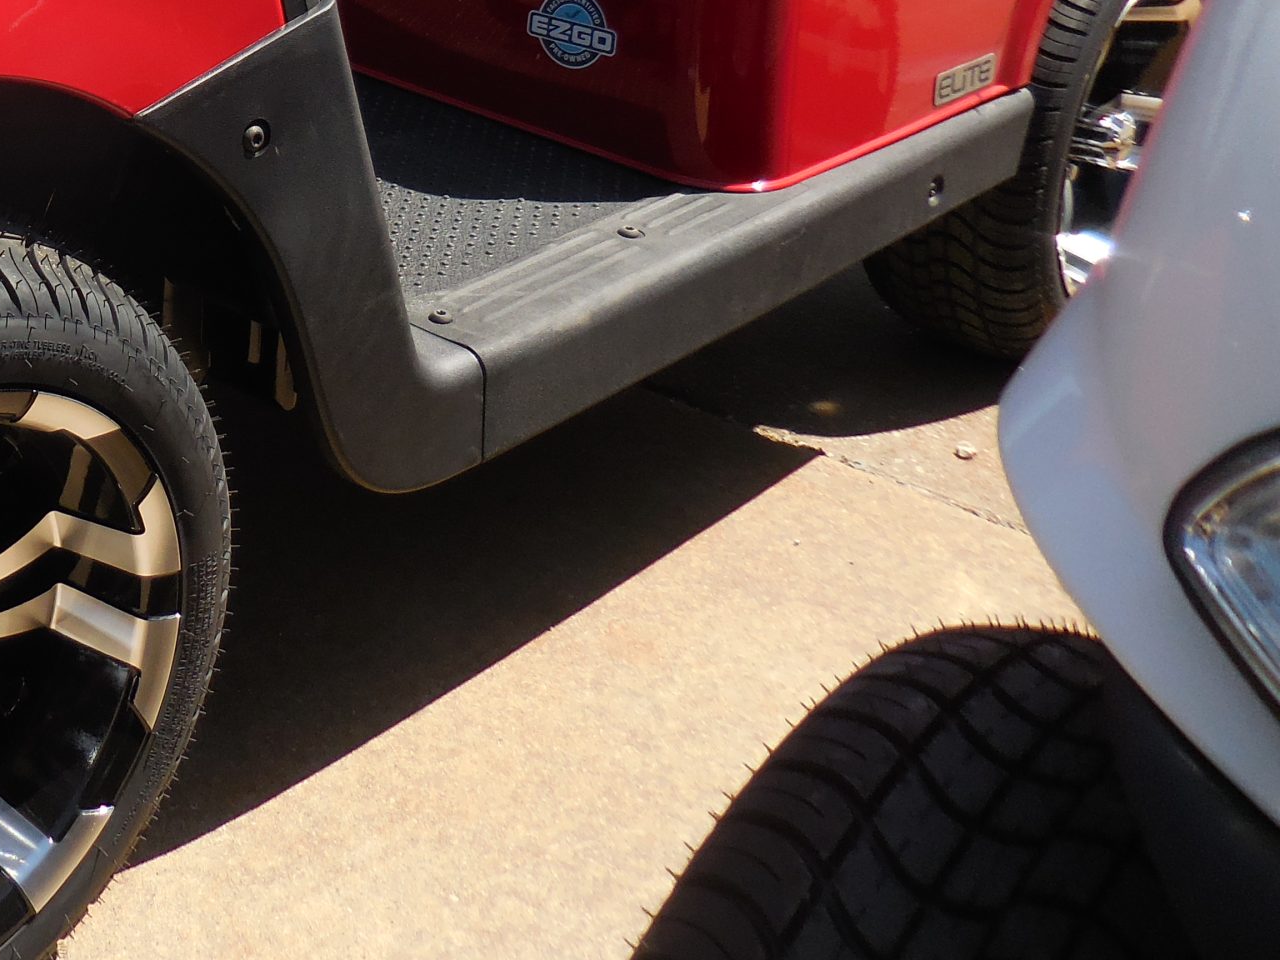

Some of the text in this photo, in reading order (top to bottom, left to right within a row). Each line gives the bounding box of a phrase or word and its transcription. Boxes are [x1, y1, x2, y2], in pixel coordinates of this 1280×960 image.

[531, 15, 612, 52] EZGO
[549, 43, 591, 62] PRE-OWNED
[939, 59, 991, 99] ELITE
